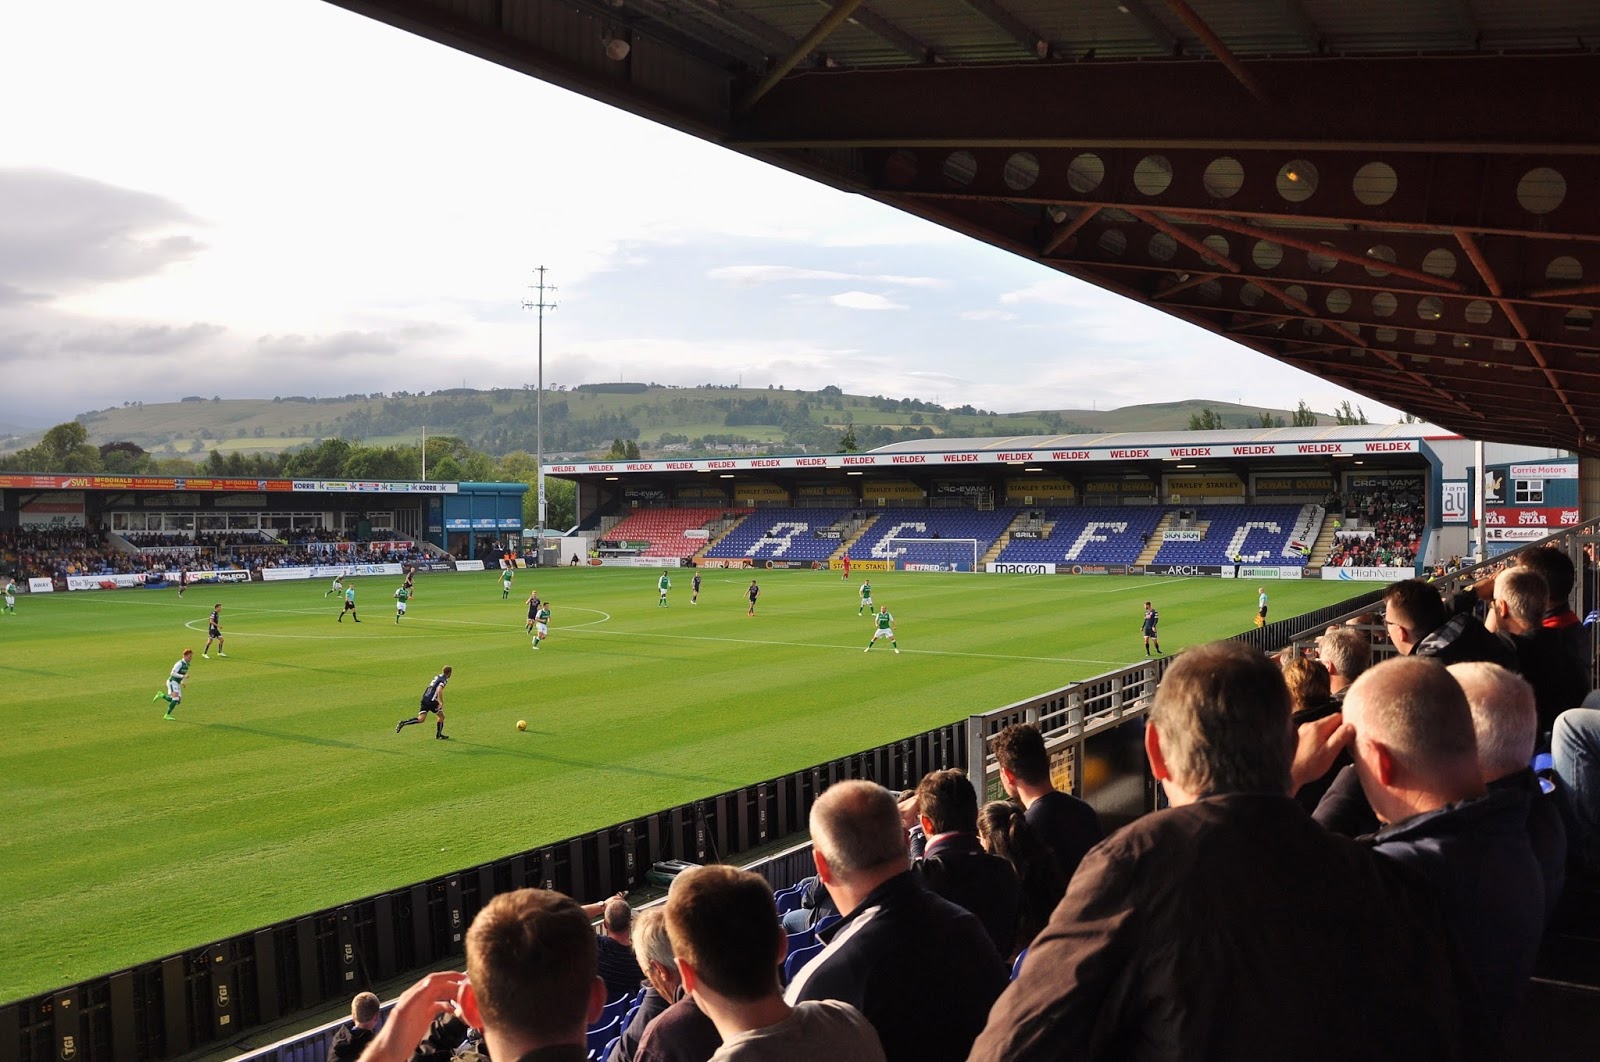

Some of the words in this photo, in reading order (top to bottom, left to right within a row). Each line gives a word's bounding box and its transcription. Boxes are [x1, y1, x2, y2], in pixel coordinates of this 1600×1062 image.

[1233, 446, 1275, 455] WELDEX
[1298, 444, 1342, 453] WELDEX
[1365, 442, 1411, 451] WELDEX
[1053, 451, 1090, 460] WELDEX
[1110, 450, 1149, 458] WELDEX
[1170, 448, 1211, 456] WELDEX
[1486, 516, 1506, 524] TAR
[1518, 516, 1547, 524] STAR
[1505, 530, 1543, 538] Coaches
[995, 565, 1046, 573] macron
[1168, 566, 1198, 575] ARCH
[1243, 569, 1278, 577] patmunro
[1352, 570, 1398, 578] HighNet
[218, 985, 227, 1002] TGI
[64, 1036, 74, 1055] TGI
